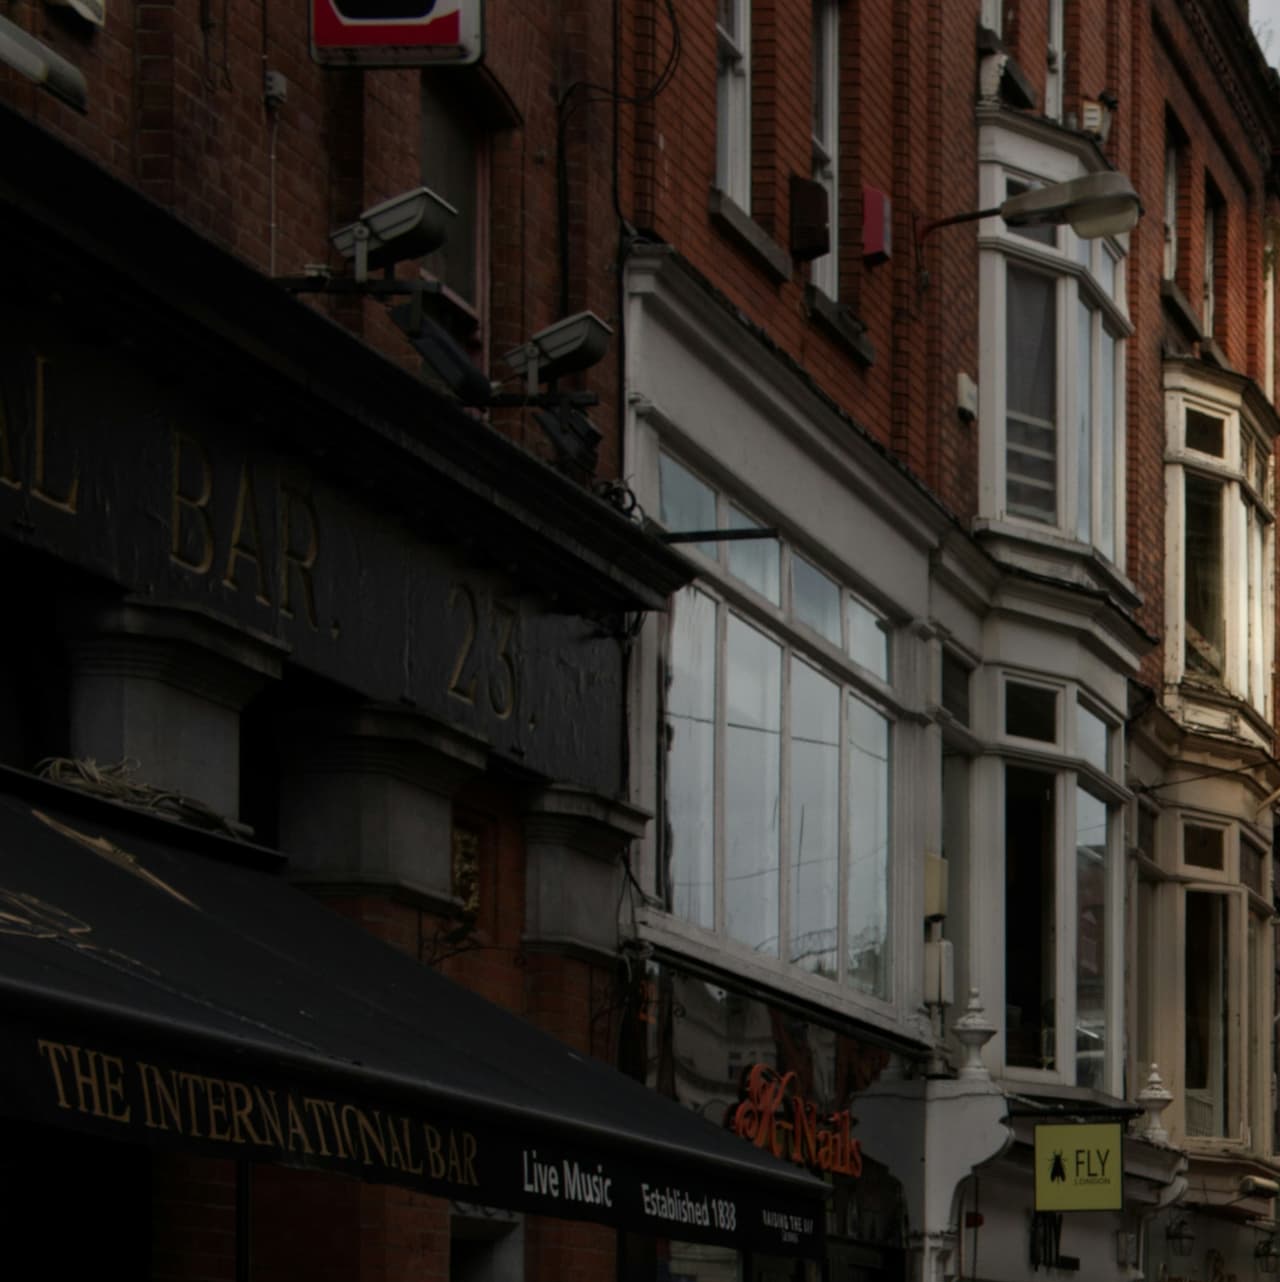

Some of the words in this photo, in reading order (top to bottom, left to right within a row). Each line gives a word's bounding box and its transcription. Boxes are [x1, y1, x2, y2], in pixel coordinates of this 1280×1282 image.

[36, 1038, 131, 1124] THE
[136, 1060, 424, 1176] INTERNATIONAL
[423, 1120, 480, 1187] BAR
[522, 1149, 560, 1198] Live
[562, 1159, 614, 1208] Music
[1074, 1148, 1111, 1177] FLY
[640, 1182, 711, 1229] Established
